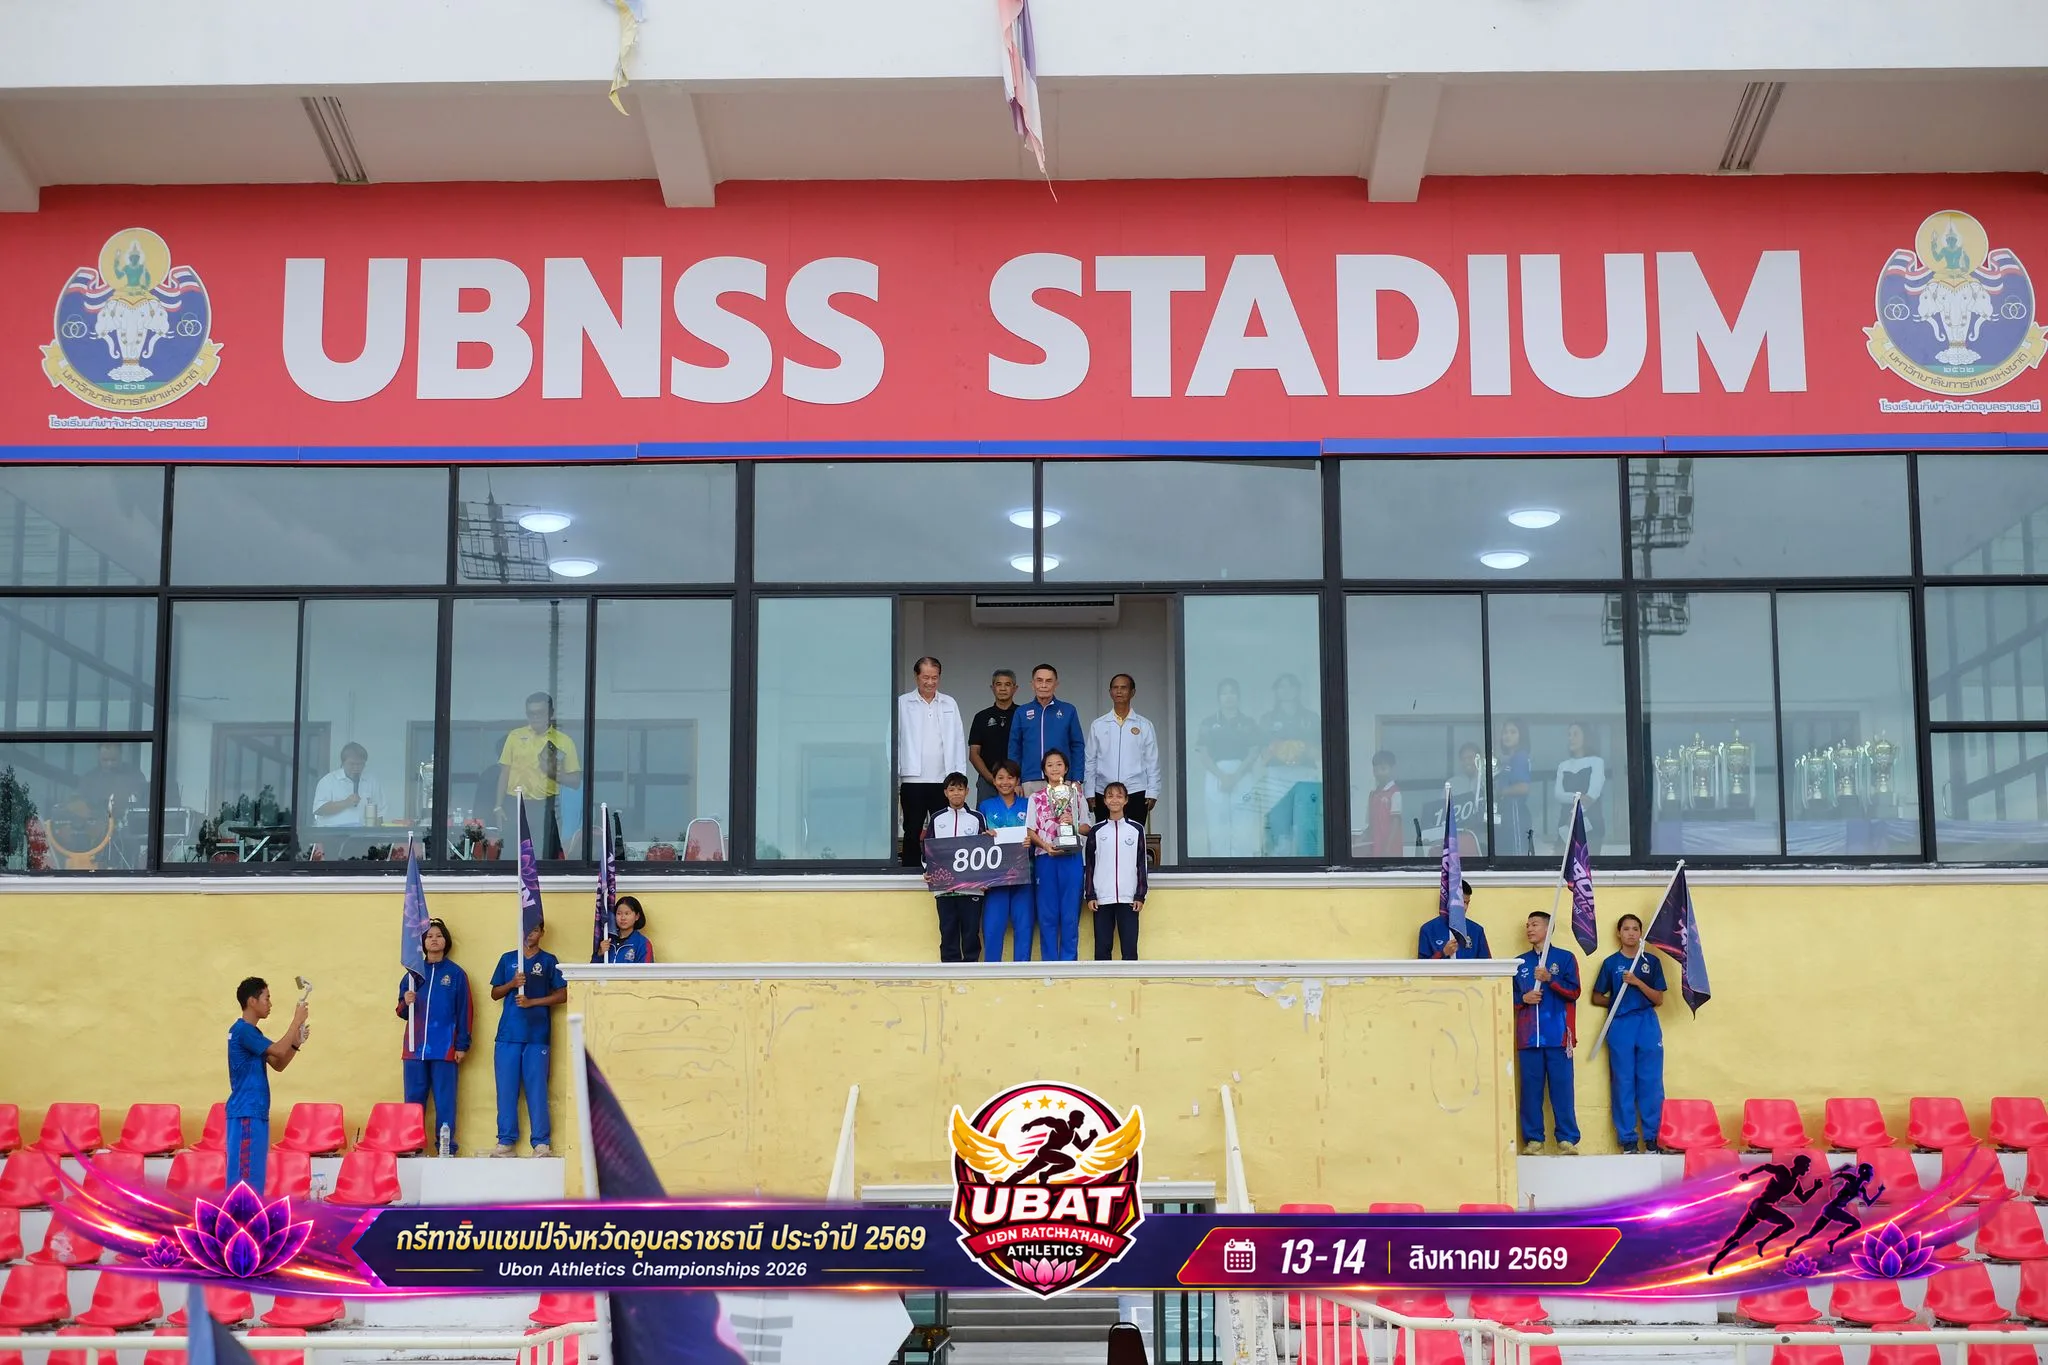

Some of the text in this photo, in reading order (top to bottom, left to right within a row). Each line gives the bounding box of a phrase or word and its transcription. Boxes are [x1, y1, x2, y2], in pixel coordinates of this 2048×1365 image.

[282, 250, 1808, 405] UBNSS STADIUM
[1888, 351, 2028, 390] มหาวิทยาลัยการกีฬาแห่งชาติ
[62, 368, 200, 407] มหาวิทยาลัยการกีฬาแห่งชาติ
[50, 416, 206, 430] โรงเรียนกีฬาจังหวัดอุบลราชธานี
[1881, 399, 2040, 414] โรงเรียนกีฬาจังหวัดอุบลราชธานี
[952, 845, 1003, 873] 800
